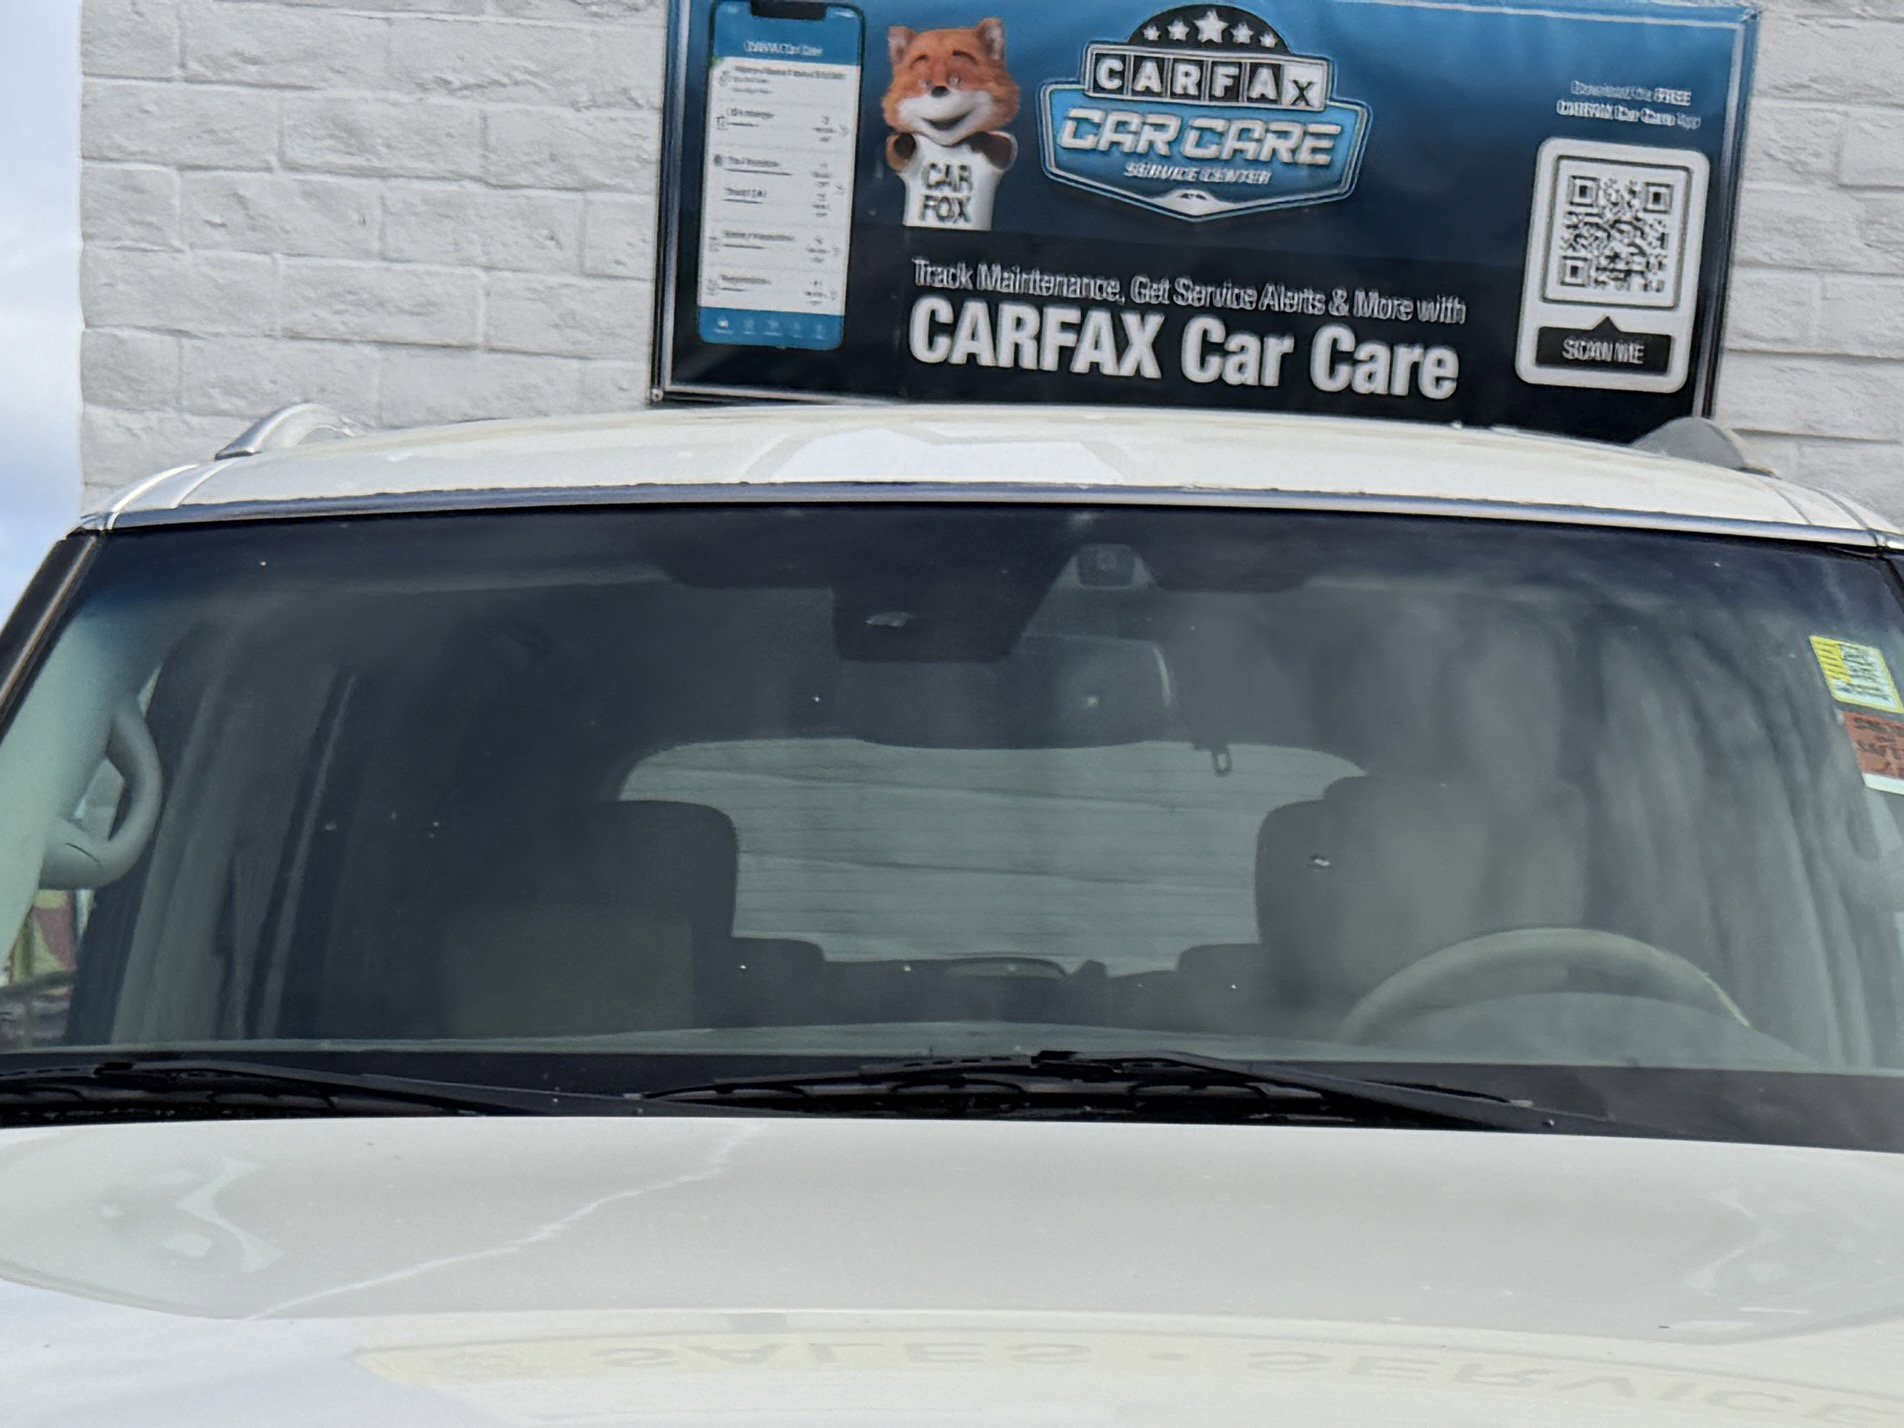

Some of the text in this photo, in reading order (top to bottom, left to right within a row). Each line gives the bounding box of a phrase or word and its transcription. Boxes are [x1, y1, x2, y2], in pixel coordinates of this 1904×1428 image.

[1095, 56, 1317, 107] CARFAX
[1058, 107, 1342, 166] CAR CARE
[921, 162, 974, 193] CAR
[1122, 161, 1273, 185] SERVICE CENTER
[919, 194, 972, 224] FOX
[912, 256, 1467, 325] Track Maintenance, Get Service Alerts & More with
[909, 295, 1460, 400] CARFAX Car Care
[1562, 338, 1645, 365] SCAN ME
